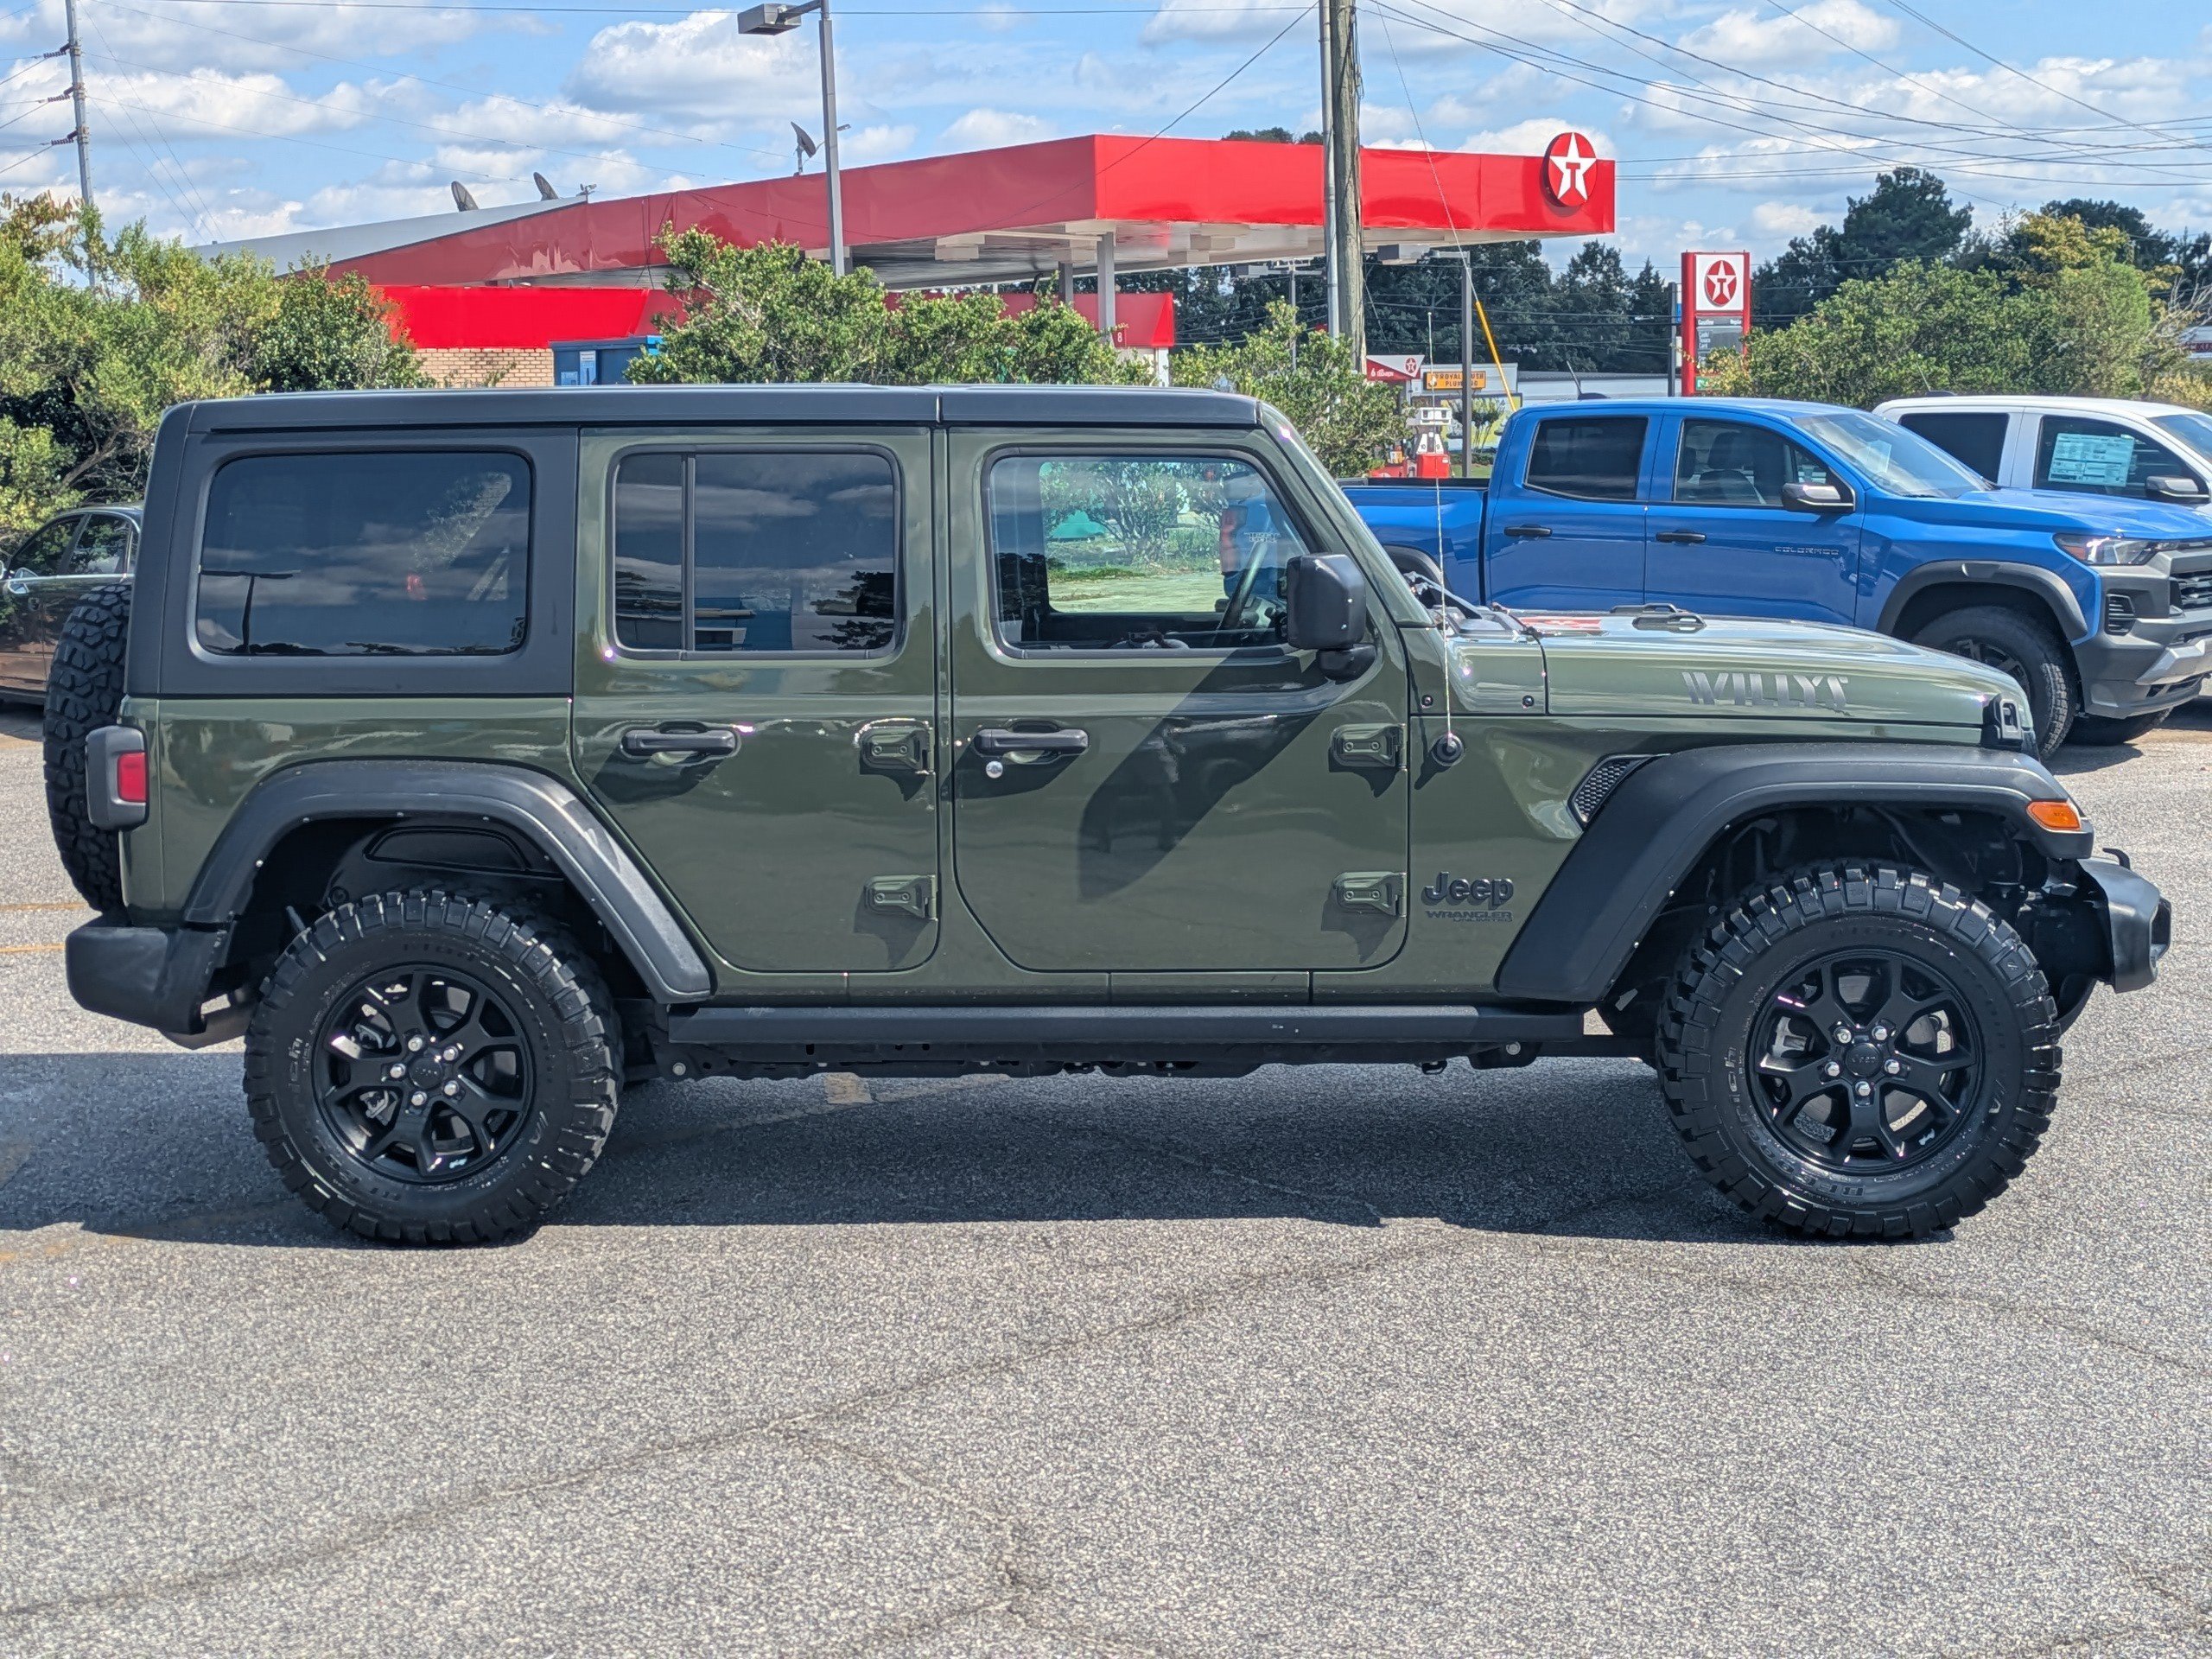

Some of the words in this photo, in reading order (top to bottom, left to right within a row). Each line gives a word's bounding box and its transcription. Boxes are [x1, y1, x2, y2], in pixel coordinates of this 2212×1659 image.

[1117, 332, 1122, 343] 8
[1775, 546, 1839, 555] COLORADO
[1682, 671, 1849, 708] WILLYS
[1424, 871, 1514, 906] Jeep
